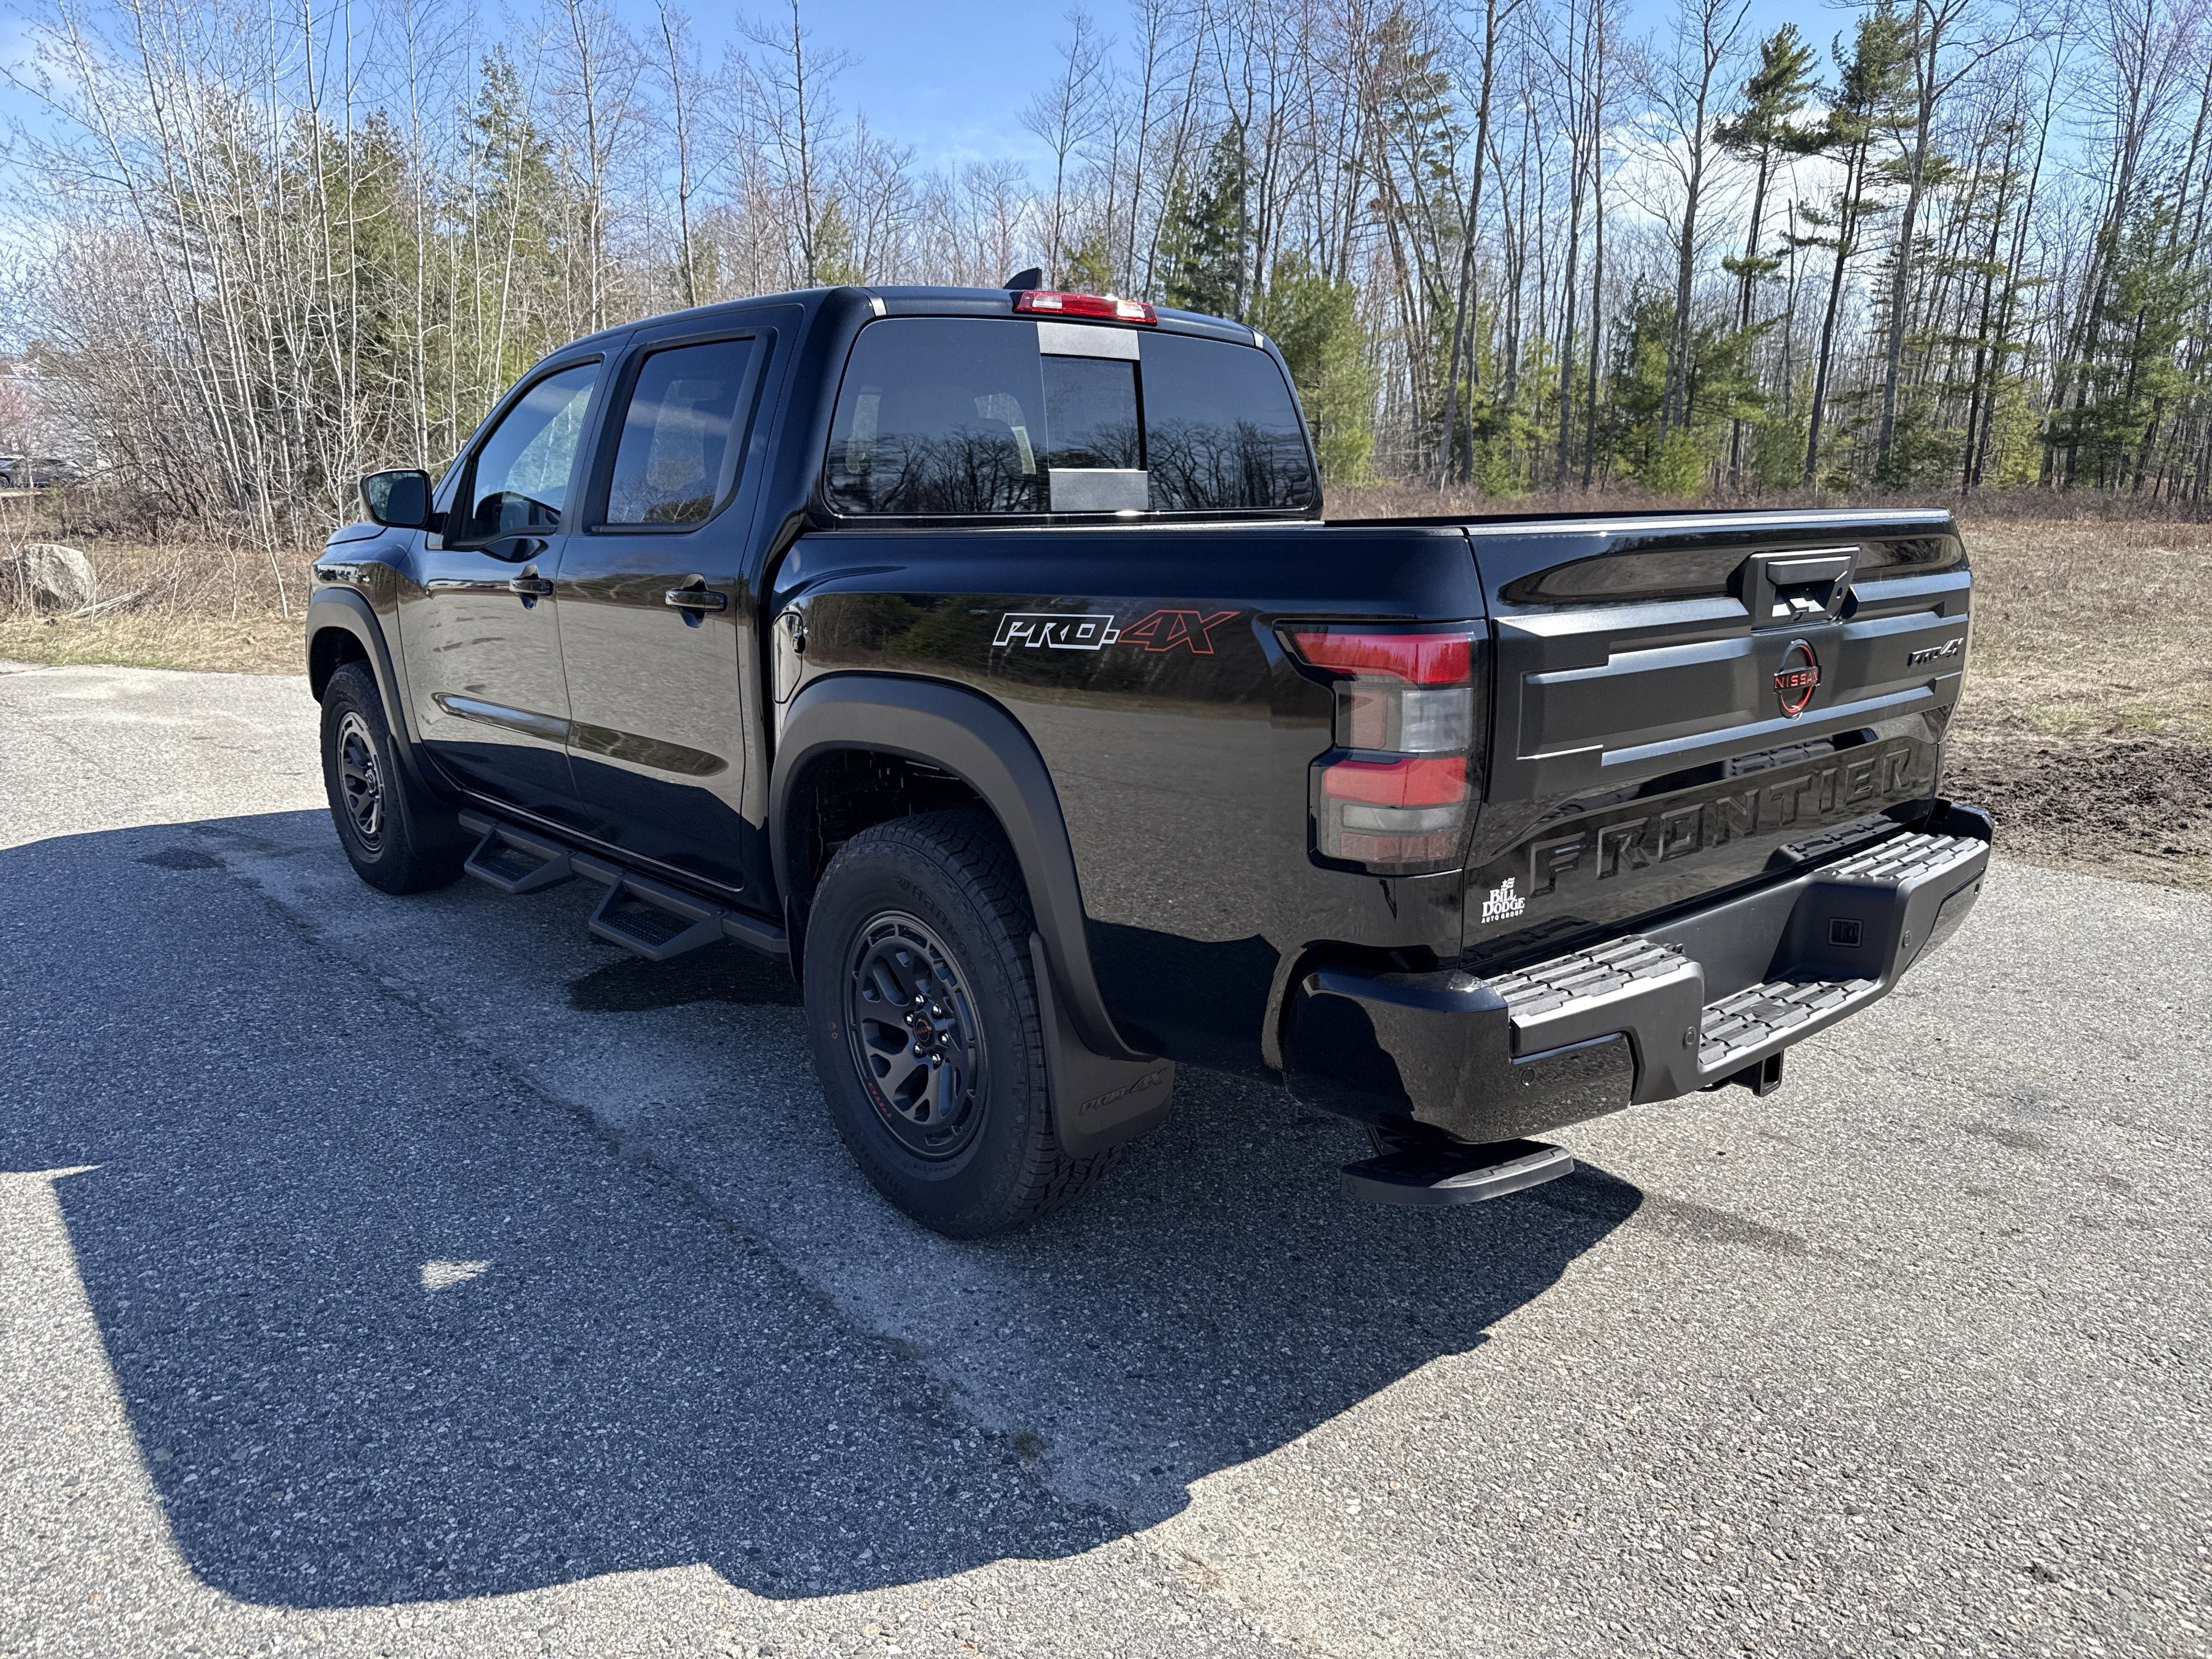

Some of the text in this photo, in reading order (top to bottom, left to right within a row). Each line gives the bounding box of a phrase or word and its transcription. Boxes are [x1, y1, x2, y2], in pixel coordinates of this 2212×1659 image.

[1774, 670, 1819, 689] NISSAN
[1530, 747, 1912, 899] FRONTIER
[1489, 889, 1517, 905] BILL
[1481, 909, 1523, 924] AUTO GROUP
[1482, 897, 1526, 917] DODGE
[912, 882, 984, 992] Hankoo
